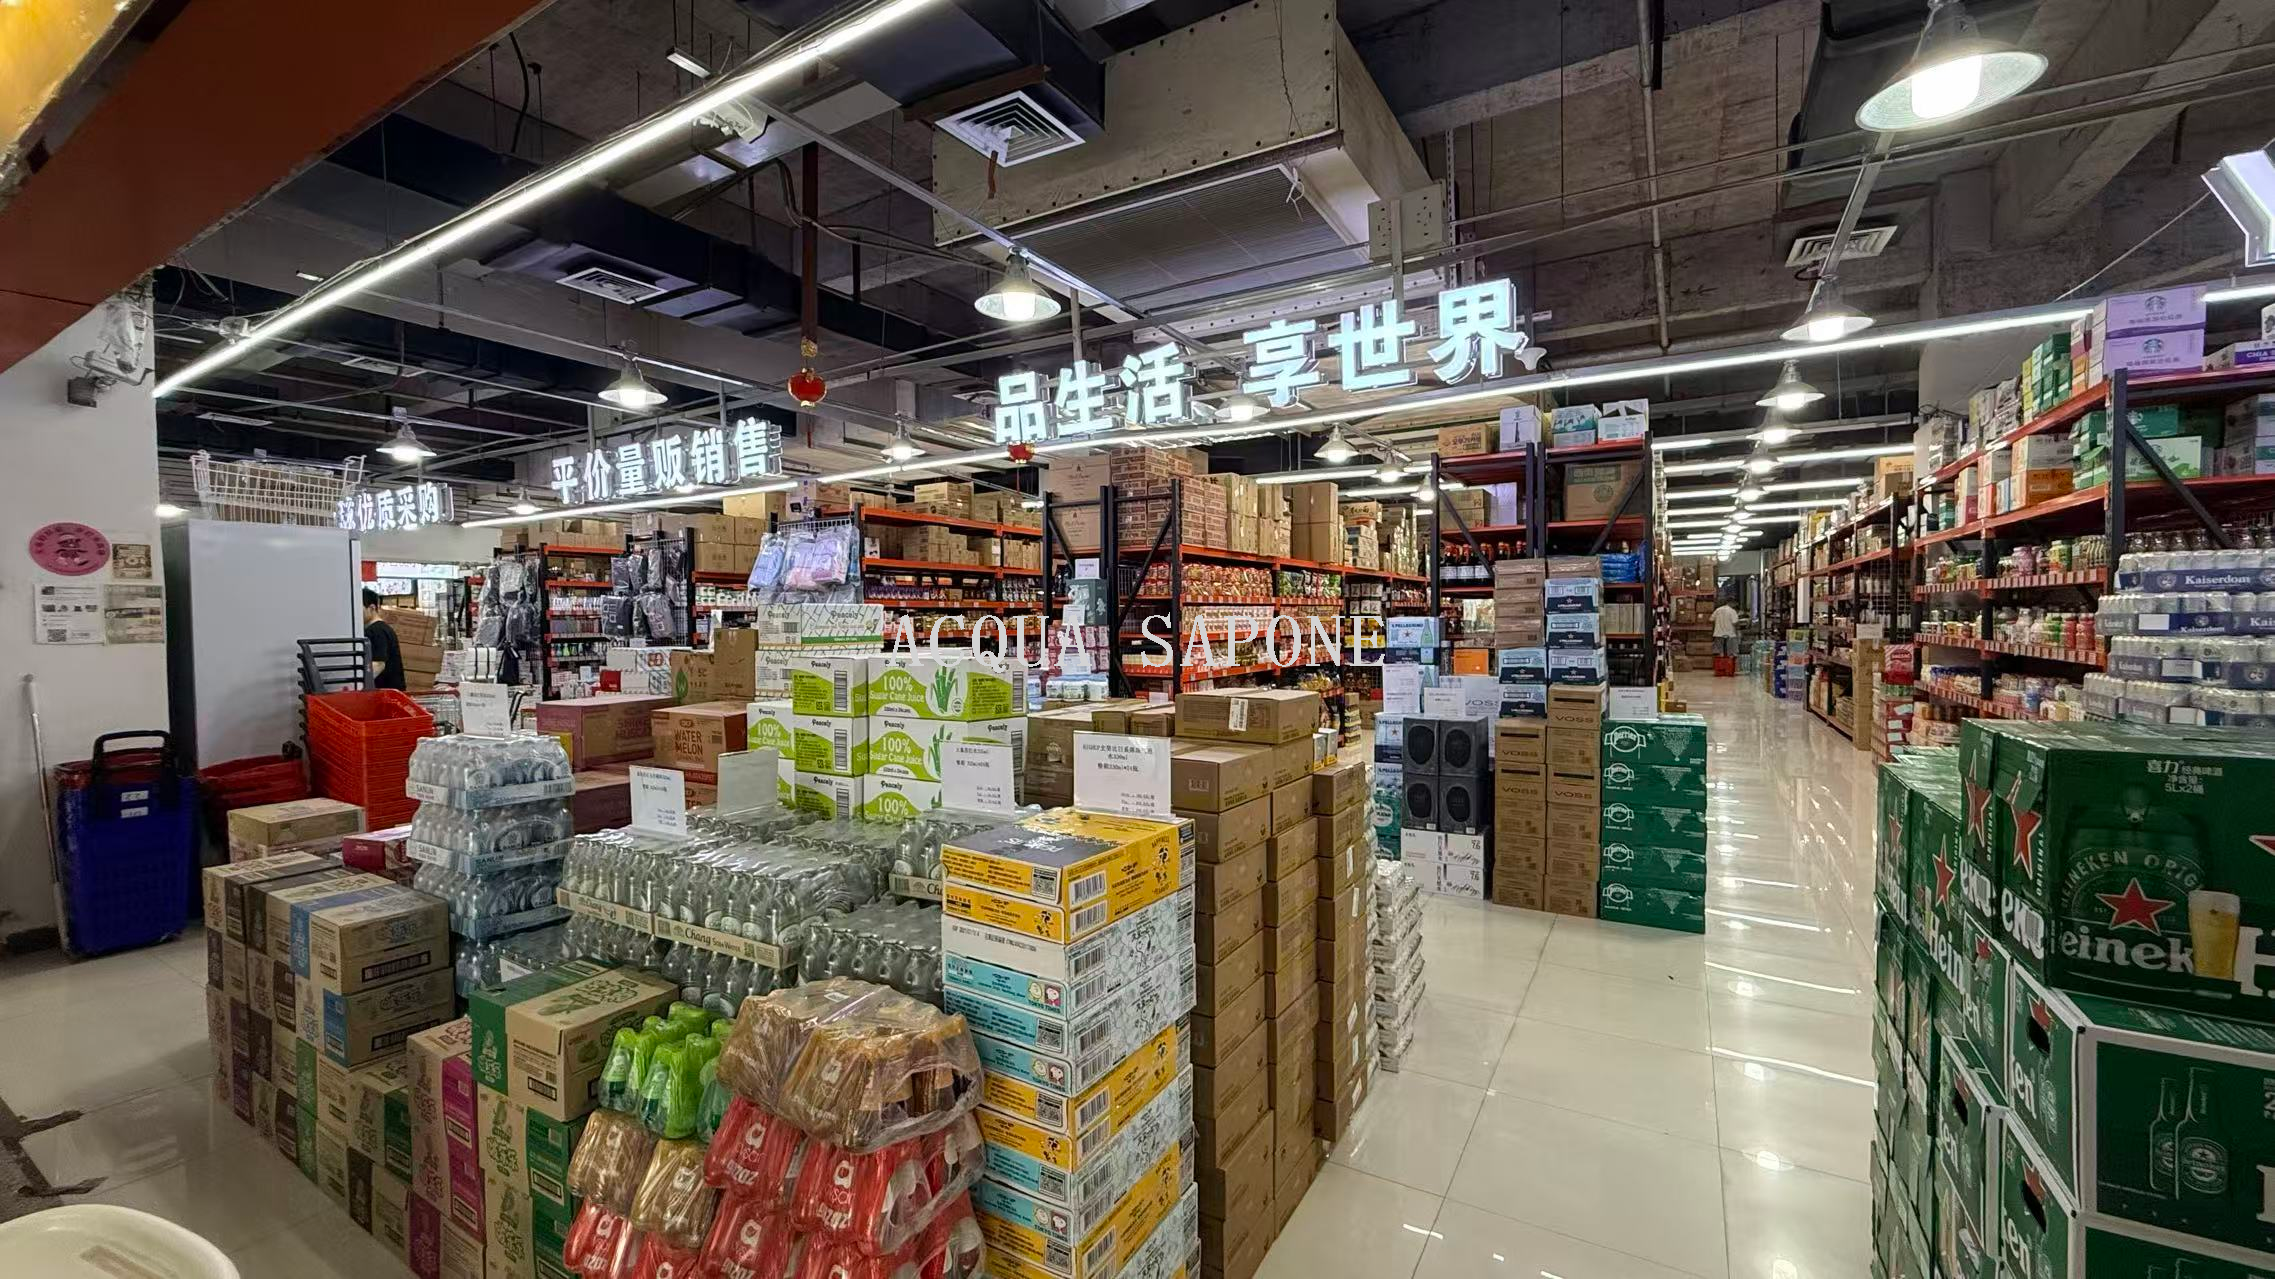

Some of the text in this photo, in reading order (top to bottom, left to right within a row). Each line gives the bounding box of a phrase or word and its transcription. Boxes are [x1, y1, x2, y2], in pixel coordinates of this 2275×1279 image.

[994, 278, 1527, 444] 品生活 享世界
[551, 416, 768, 505] 平价量贩销售
[2185, 574, 2251, 586] Kaiserdom
[830, 610, 859, 620] Peacely
[811, 660, 832, 669] Peacely
[883, 675, 913, 692] 100%
[812, 718, 832, 728] Peacely
[884, 720, 905, 730] Peacely
[1555, 715, 1594, 724] VOSS
[757, 723, 781, 737] 100%
[674, 729, 702, 744] WATER
[675, 741, 703, 756] MELON
[882, 737, 912, 754] 100%
[1502, 750, 1538, 758] VOSS
[813, 776, 833, 786] Peacely
[881, 780, 903, 791] Peacely
[1502, 786, 1539, 795] VOSS
[1554, 790, 1593, 800] VOSS
[878, 797, 909, 816] 100%
[2036, 830, 2044, 897] ORIGINAL
[684, 926, 712, 945] Chang
